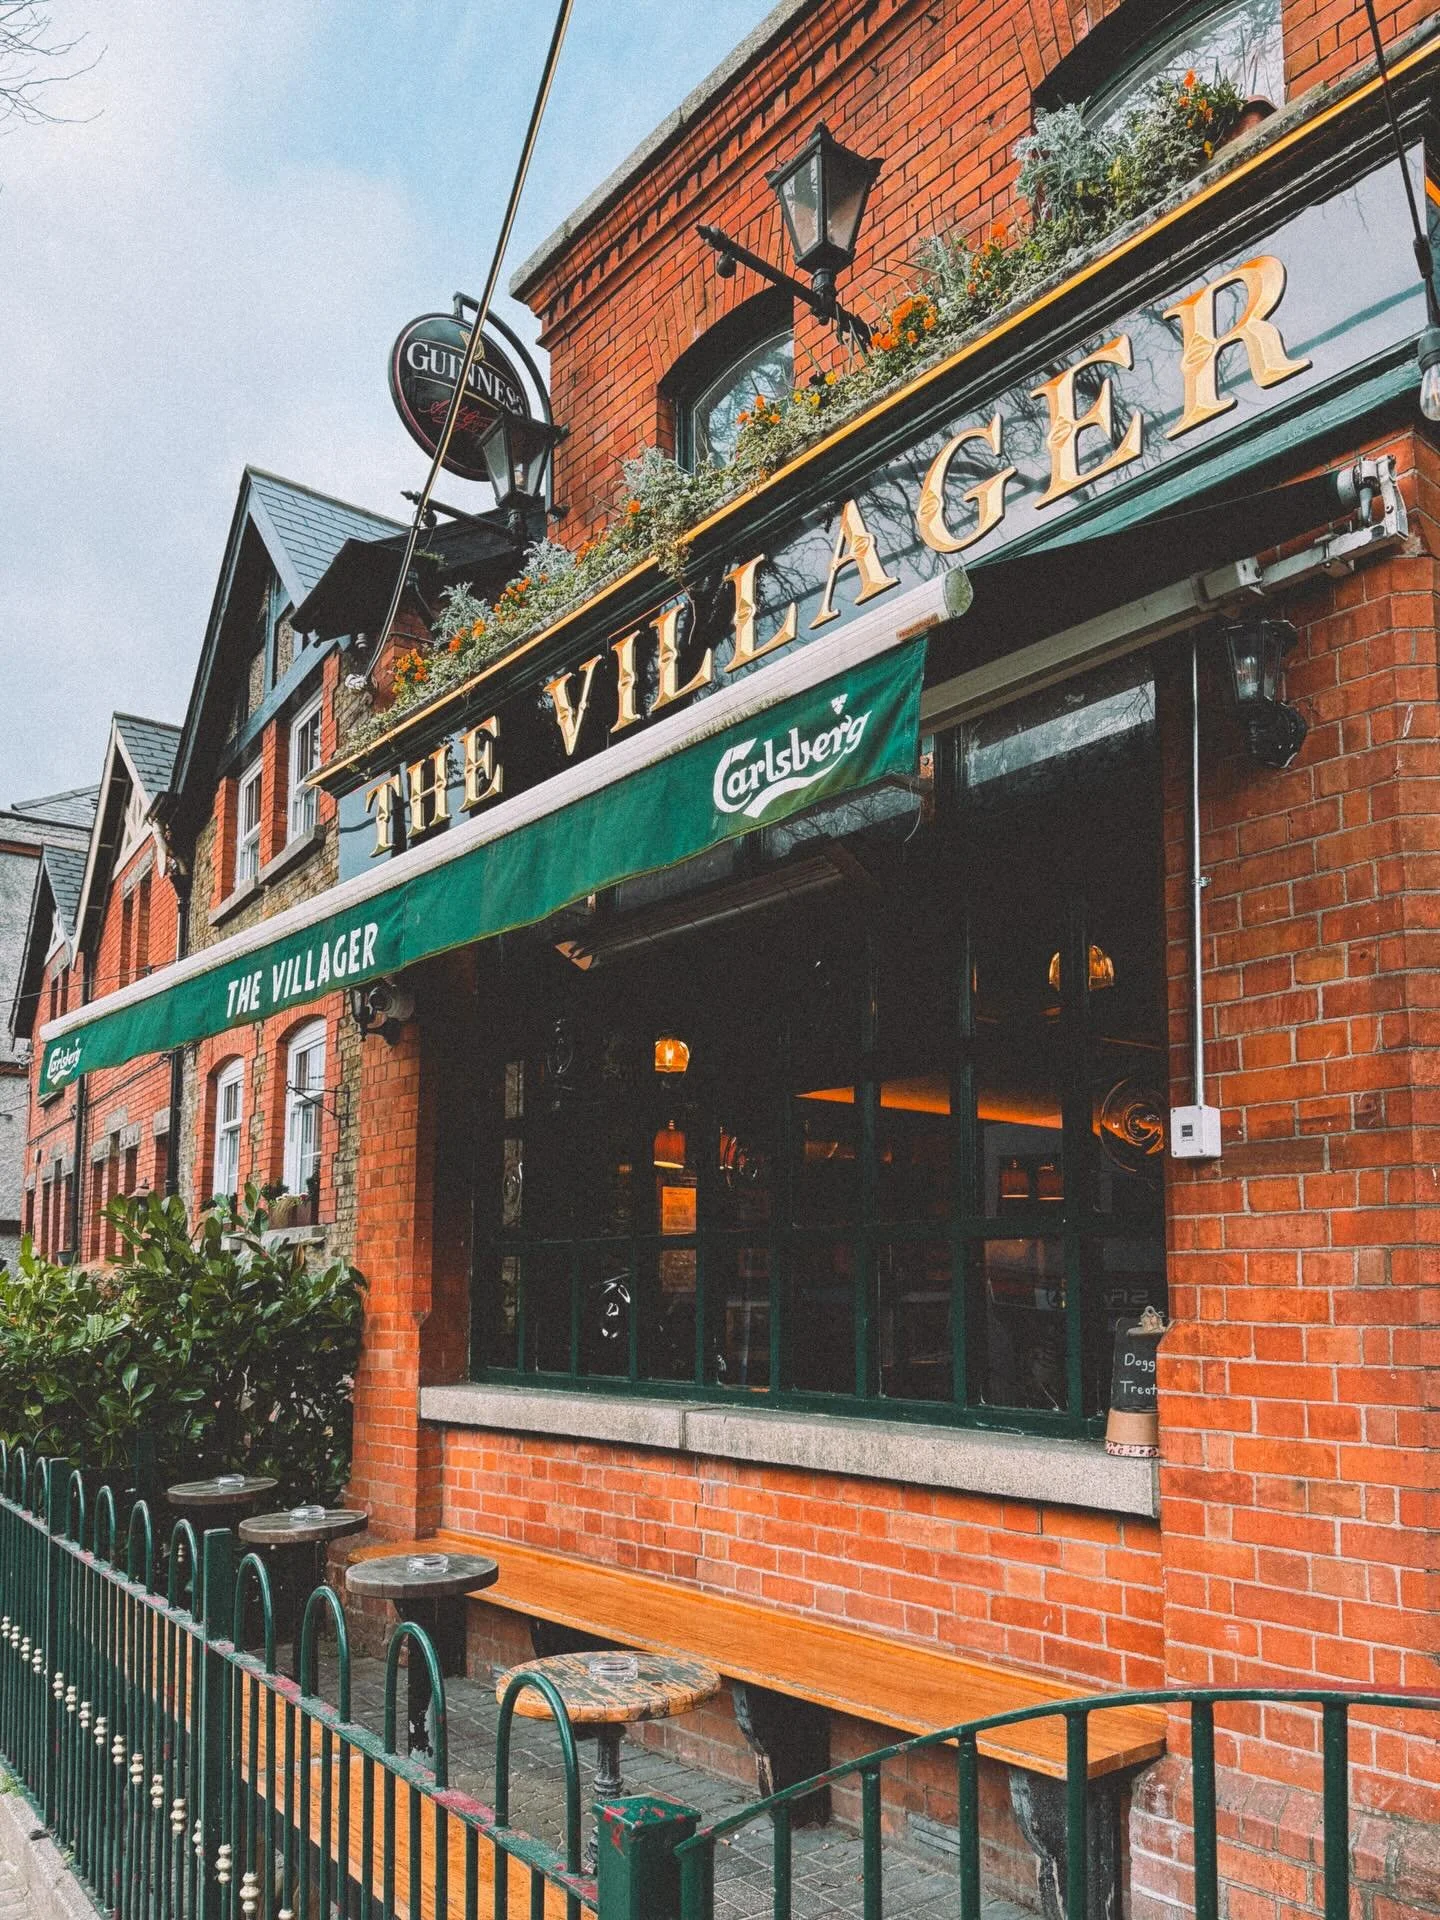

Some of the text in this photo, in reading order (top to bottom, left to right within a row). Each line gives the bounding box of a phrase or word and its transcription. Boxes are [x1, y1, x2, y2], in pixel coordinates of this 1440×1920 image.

[365, 255, 1312, 858] THE VILLAGER
[712, 709, 872, 815] Carlsberg
[226, 922, 379, 1018] THE VILLAGER
[46, 1045, 82, 1082] Carlsberg
[1124, 1352, 1155, 1373] Dogg
